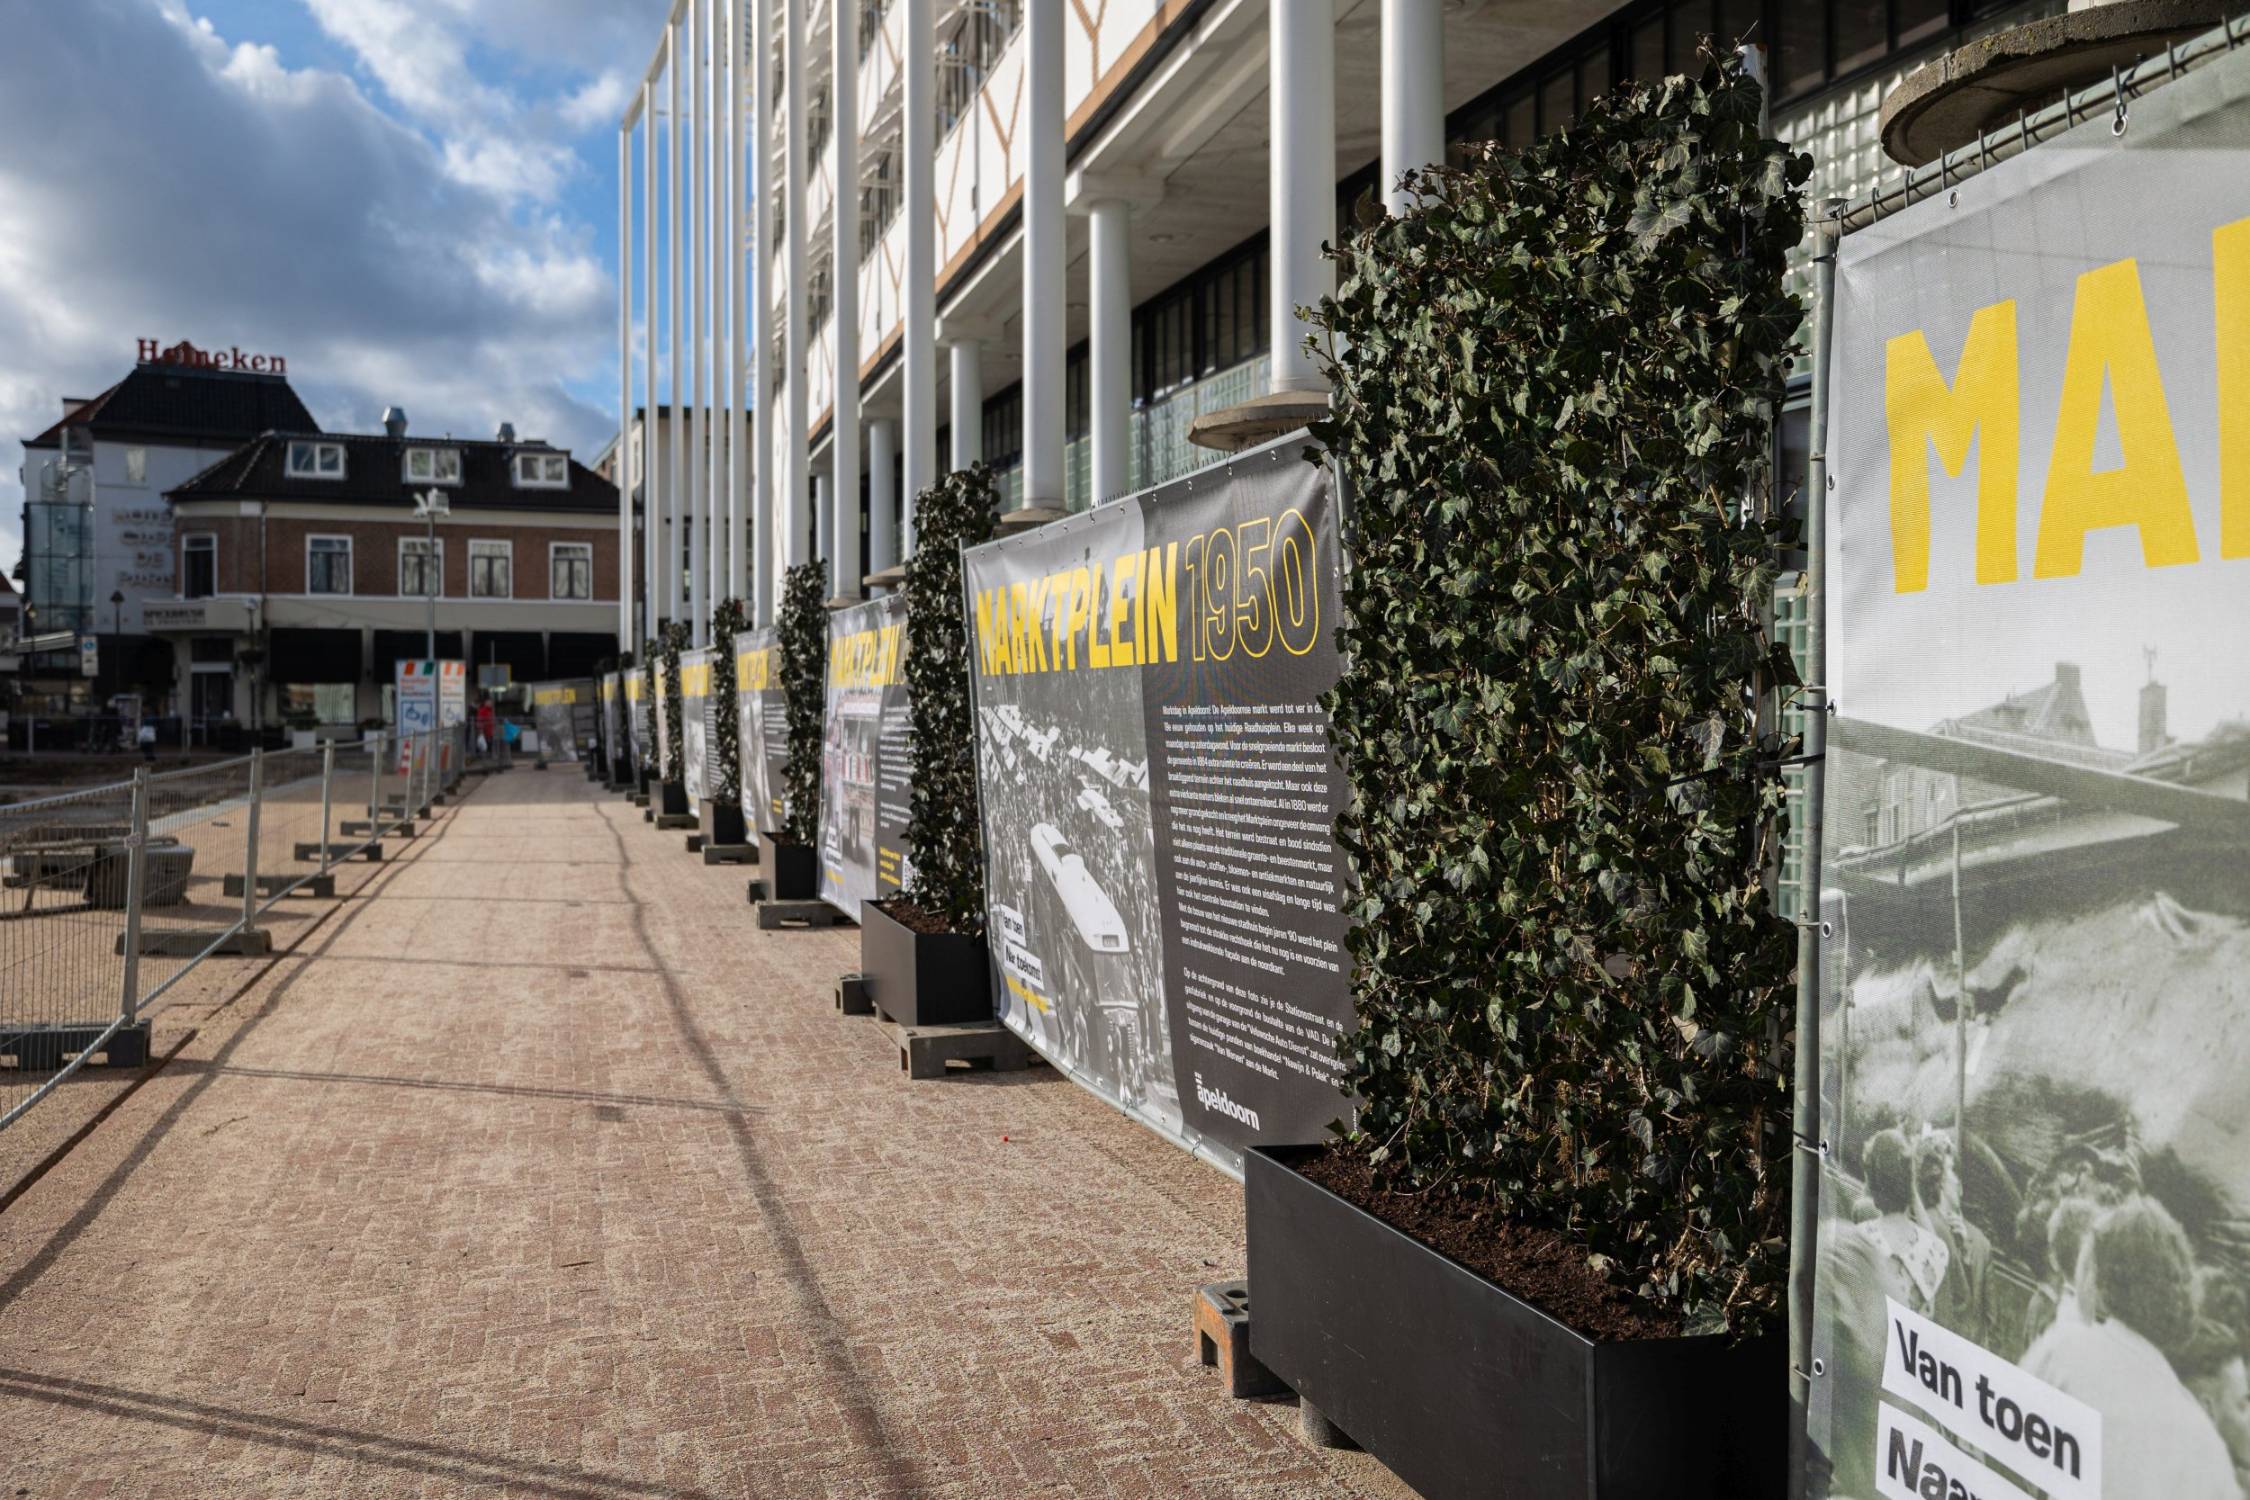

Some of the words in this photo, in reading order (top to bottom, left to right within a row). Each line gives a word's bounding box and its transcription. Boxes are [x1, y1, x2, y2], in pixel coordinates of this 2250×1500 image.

[977, 542, 1178, 675] MARKTPLEIN
[1186, 508, 1320, 661] 1950
[1269, 704, 1283, 714] werd
[1285, 704, 1294, 713] tot
[1306, 703, 1313, 713] in
[1283, 723, 1295, 732] Elke
[1298, 723, 1313, 733] week
[1315, 725, 1324, 735] op
[1285, 742, 1302, 752] markt
[1302, 742, 1325, 752] besloot
[1304, 764, 1316, 772] van
[1315, 762, 1327, 773] het
[1285, 780, 1300, 791] Maar
[1301, 781, 1313, 792] ook
[1313, 782, 1327, 793] deze
[1278, 798, 1284, 808] Al
[1284, 799, 1291, 809] in
[1290, 799, 1306, 811] 1880
[1306, 802, 1321, 812] werd
[1321, 804, 1329, 813] er
[1299, 819, 1306, 830] de
[1306, 822, 1331, 835] omvang
[1279, 838, 1286, 846] en
[1287, 837, 1302, 849] bood
[1302, 839, 1331, 853] sindsdien
[1269, 855, 1276, 864] en
[1276, 854, 1317, 873] beestenmarkt,
[1317, 863, 1333, 873] maar
[1297, 878, 1305, 887] en
[1305, 878, 1334, 895] natuurlijk
[1286, 895, 1294, 904] en
[1294, 894, 1311, 909] lange
[1311, 898, 1322, 912] tijd
[1323, 902, 1336, 913] was
[1297, 935, 1312, 946] werd
[1312, 936, 1323, 949] het
[1323, 940, 1338, 953] plein
[1261, 941, 1271, 953] het
[1278, 948, 1289, 961] nog
[1290, 949, 1296, 960] is
[1295, 953, 1303, 962] en
[1303, 955, 1327, 969] voorzien
[1327, 962, 1339, 973] van
[1269, 997, 1275, 1010] je
[1276, 999, 1283, 1011] de
[1326, 1018, 1334, 1029] en
[1335, 1019, 1343, 1032] de
[1296, 1024, 1304, 1036] de
[1321, 1033, 1330, 1046] De
[1305, 1064, 1310, 1076] &
[1196, 1083, 1260, 1131] apeldoorn
[1895, 1319, 1963, 1410] Van
[1976, 1374, 2081, 1480] toen
